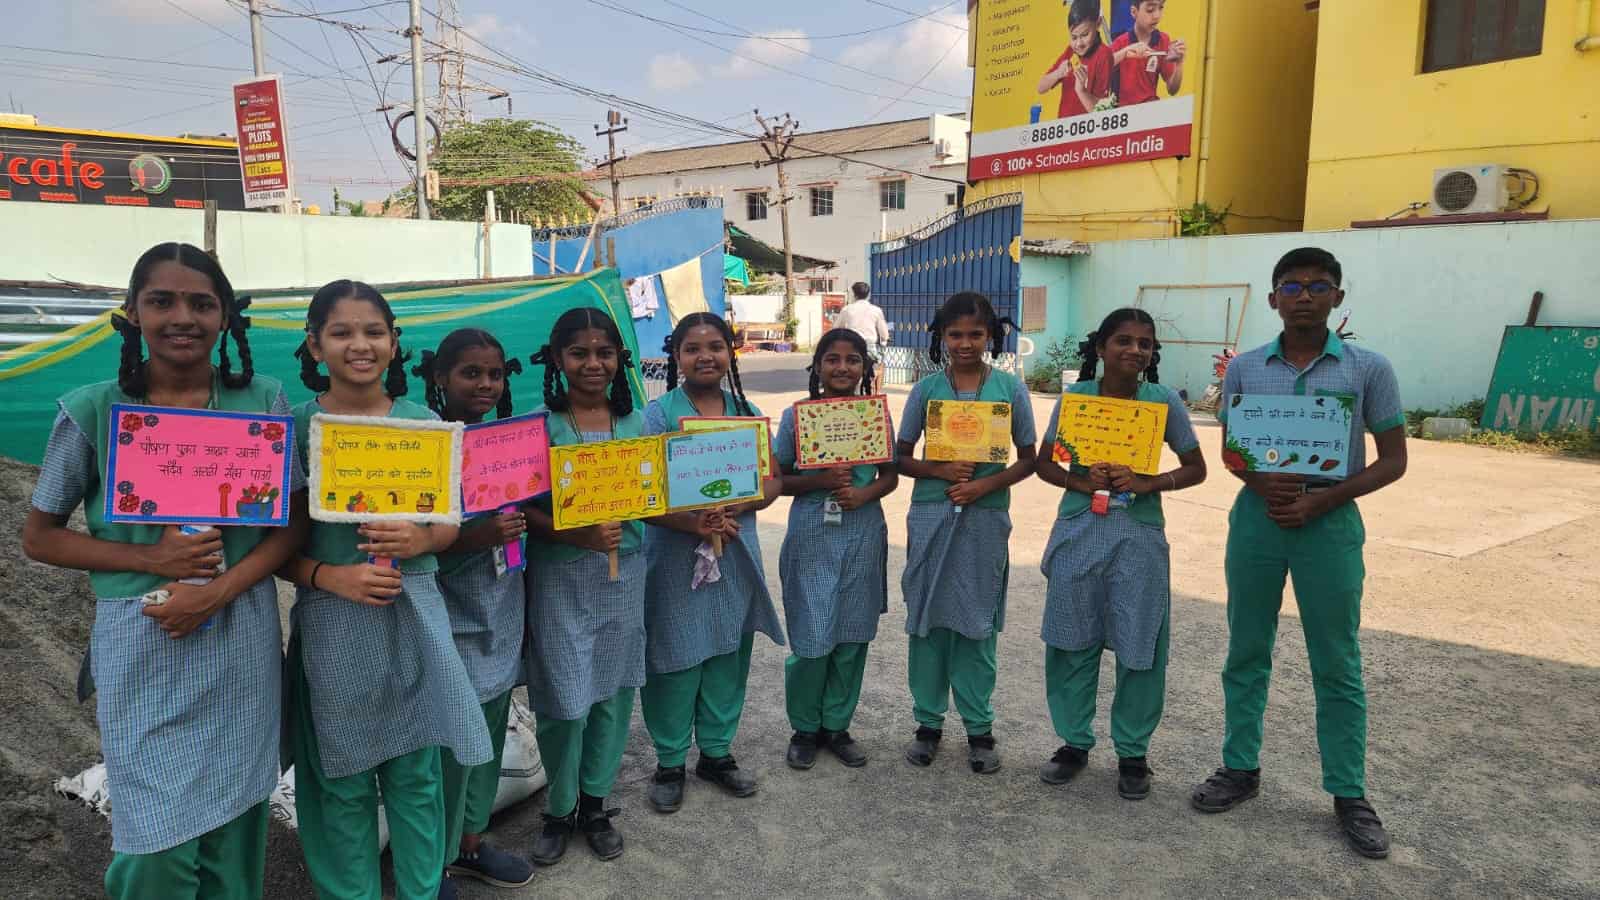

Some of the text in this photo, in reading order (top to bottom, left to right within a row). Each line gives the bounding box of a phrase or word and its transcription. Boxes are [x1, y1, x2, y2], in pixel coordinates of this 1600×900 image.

[249, 130, 272, 143] PLOTS
[1031, 113, 1128, 143] 8888-060-888
[8, 142, 105, 190] cafe
[1007, 135, 1164, 171] 100+ Schools Across India
[1494, 393, 1600, 434] MAN
